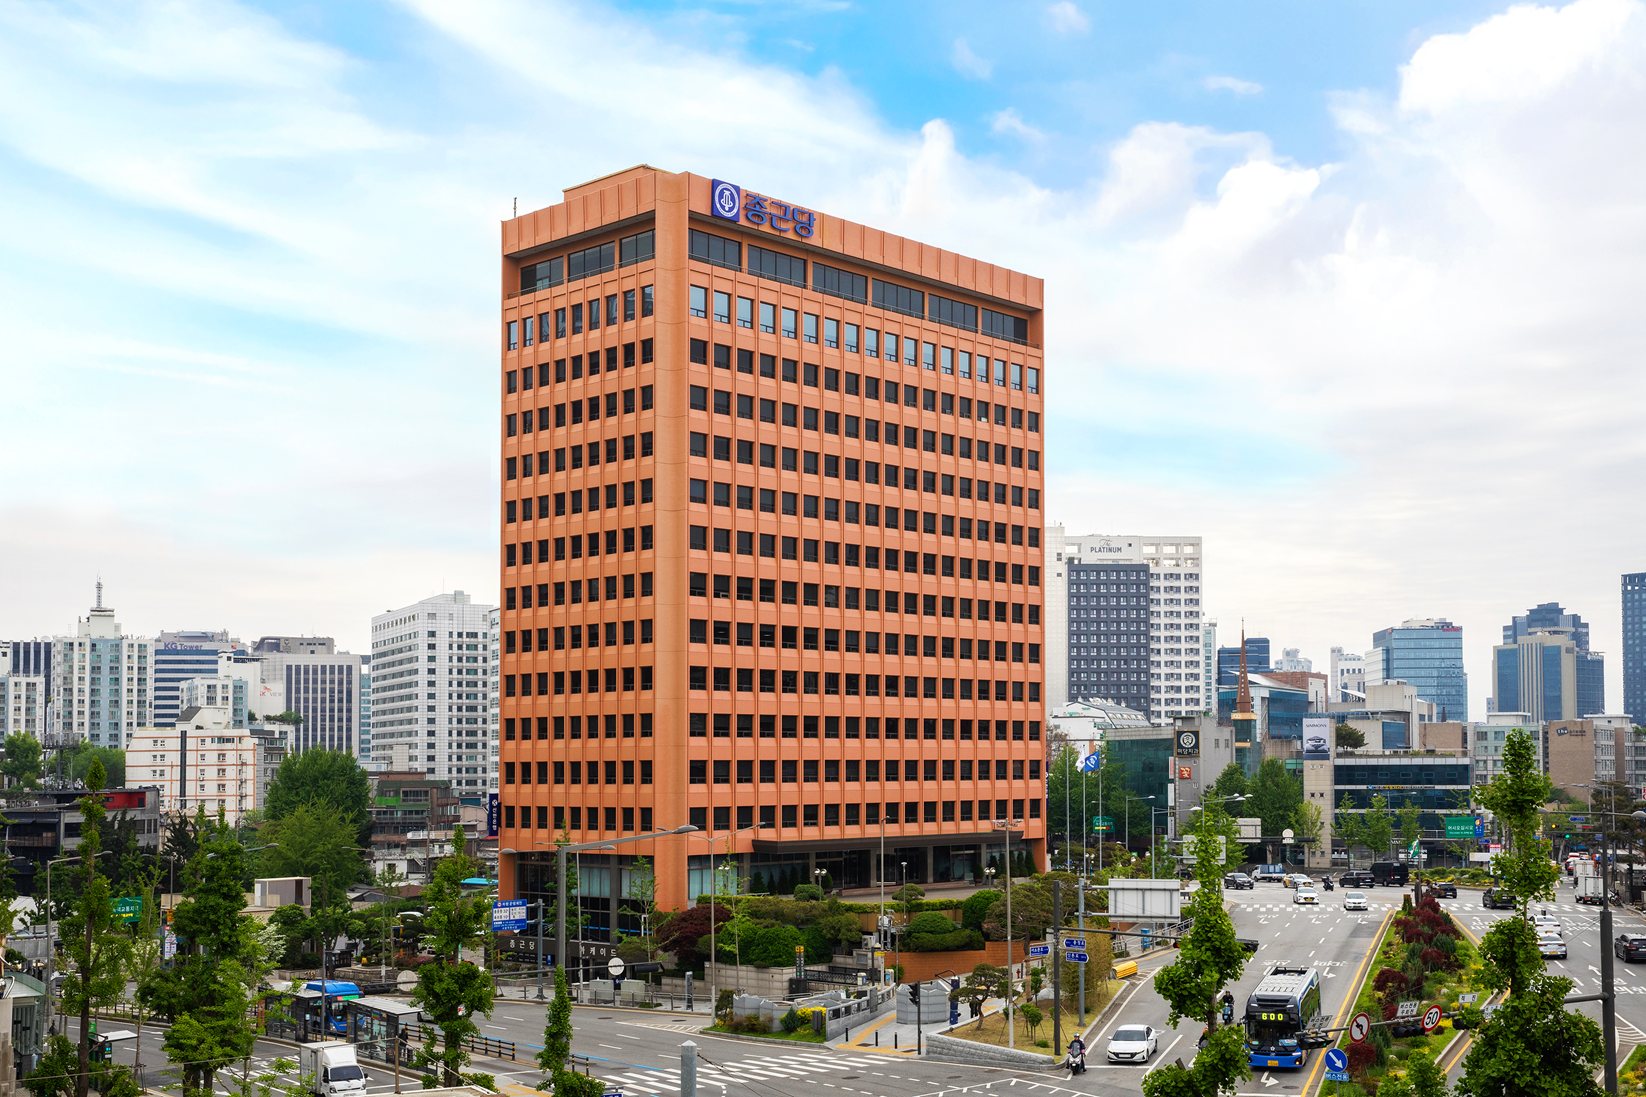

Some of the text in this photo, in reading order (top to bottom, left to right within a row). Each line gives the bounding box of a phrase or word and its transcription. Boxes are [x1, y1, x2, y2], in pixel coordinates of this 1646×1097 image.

[745, 193, 817, 238] 종근당
[164, 642, 178, 650] KG
[509, 940, 535, 950] 종근당
[1261, 1013, 1284, 1021] 600
[1425, 1011, 1439, 1026] 50
[1326, 1072, 1348, 1080] 버스전용
